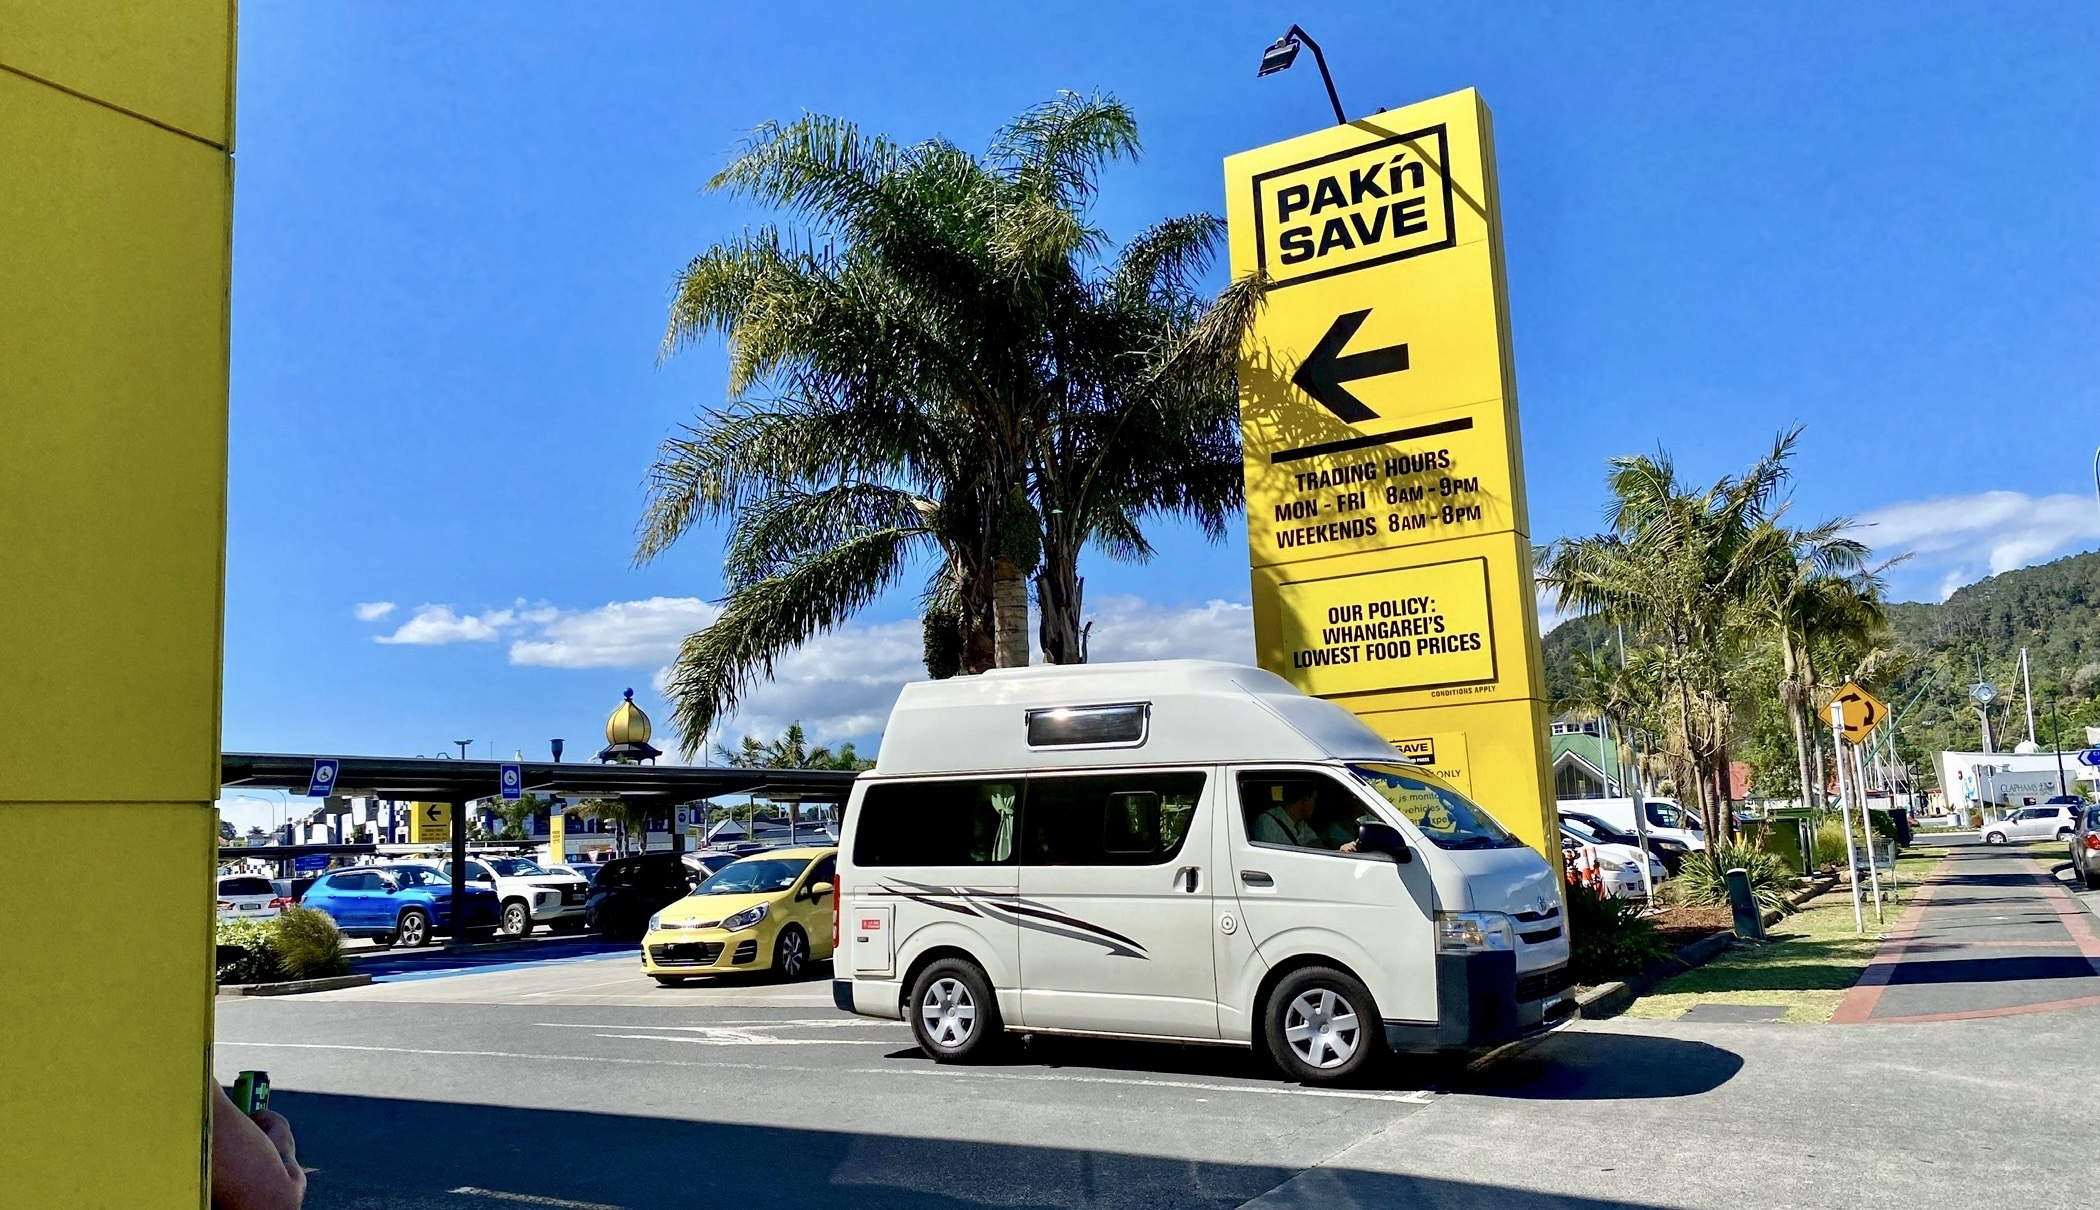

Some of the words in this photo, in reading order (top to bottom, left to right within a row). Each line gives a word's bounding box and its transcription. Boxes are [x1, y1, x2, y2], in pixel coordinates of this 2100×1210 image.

[1279, 196, 1428, 265] SAVE
[1295, 462, 1376, 492] TRADING
[1385, 449, 1450, 477] HOURS
[1275, 499, 1318, 522] MON
[1337, 492, 1366, 512] FRI
[1386, 485, 1424, 505] 8AM
[1440, 477, 1479, 497] 9PM
[1276, 517, 1377, 549] WEEKENDS
[1388, 513, 1426, 532] 8AM
[1442, 505, 1481, 525] 8PM
[1323, 615, 1445, 644] WHANGAREI'S
[1328, 605, 1363, 624] OUR
[1368, 596, 1436, 619] POLICY:
[1293, 645, 1360, 669] LOWEST
[1366, 640, 1412, 662] FOOD
[1417, 632, 1481, 656] PRICES
[1431, 687, 1473, 697] CONDITIONS
[1474, 685, 1496, 693] APPLY
